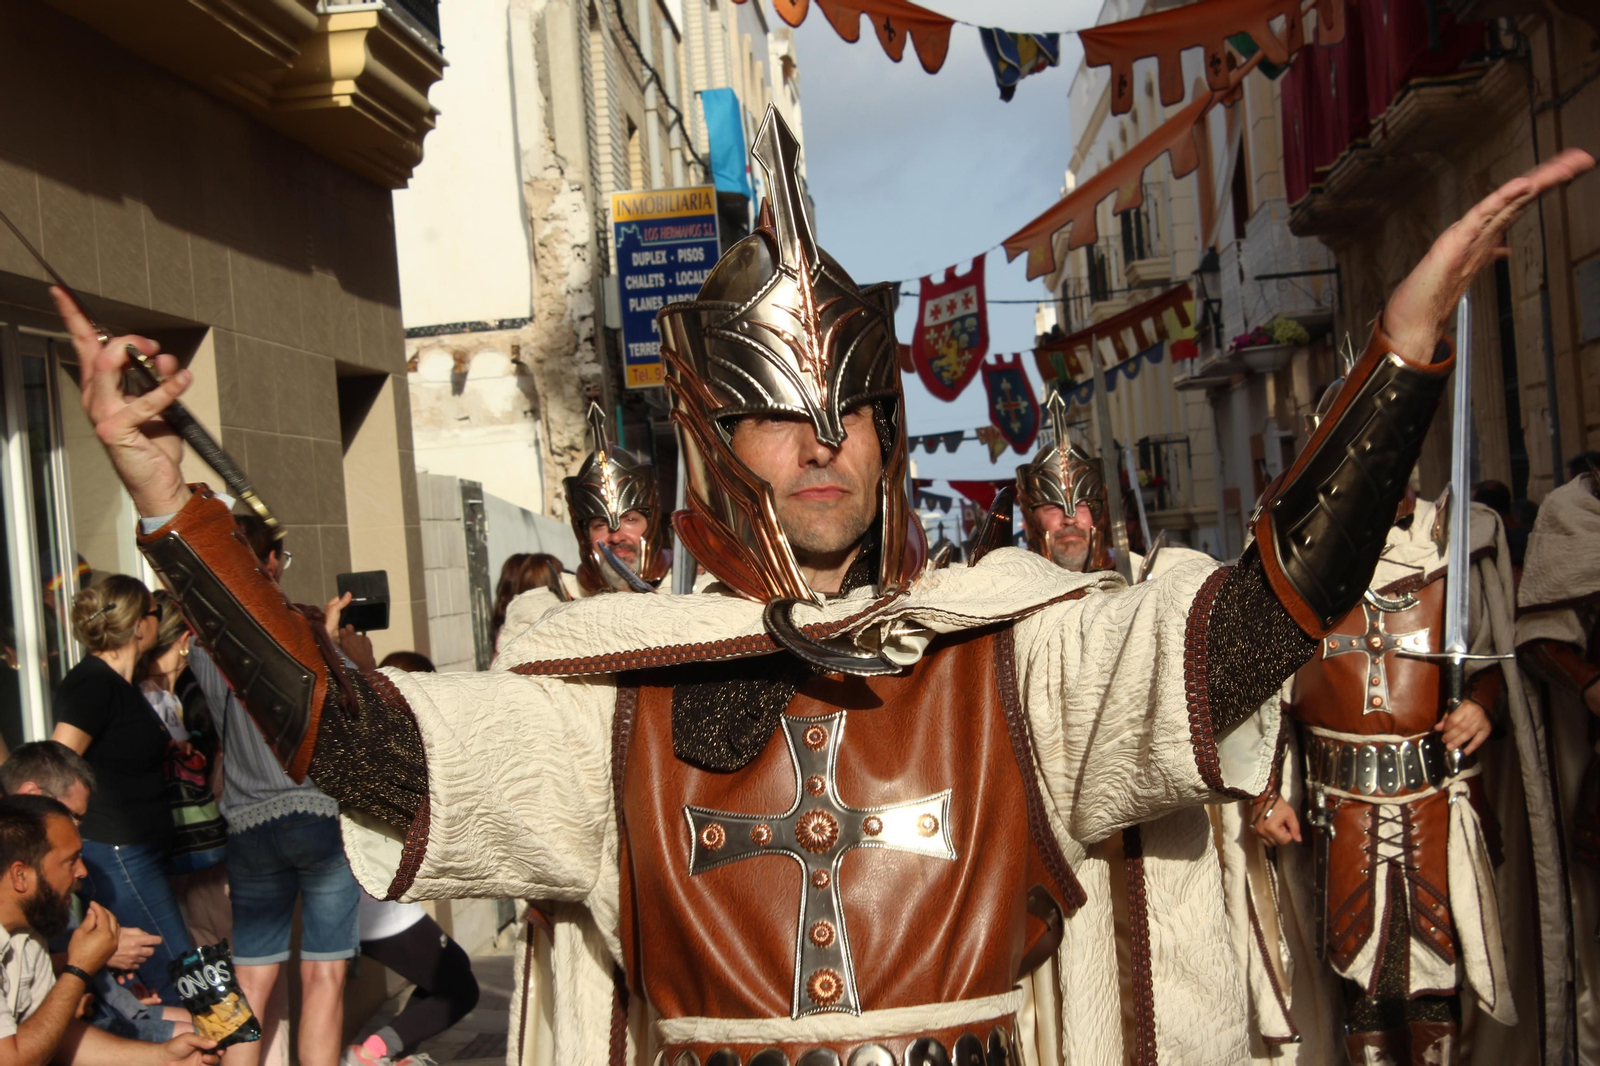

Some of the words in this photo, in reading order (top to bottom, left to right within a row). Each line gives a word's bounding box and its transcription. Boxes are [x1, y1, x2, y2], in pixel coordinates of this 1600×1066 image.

[617, 193, 712, 216] INMOBILIARIA
[644, 227, 658, 241] LOS
[660, 224, 702, 240] HERMANOS
[632, 250, 667, 266] DUPLEX
[677, 248, 704, 263] PISOS
[625, 274, 665, 289] CHALETS
[676, 269, 712, 286] LOCALE
[629, 296, 663, 312] PLANES
[632, 368, 652, 382] Tel.
[176, 960, 232, 999] ONOS
